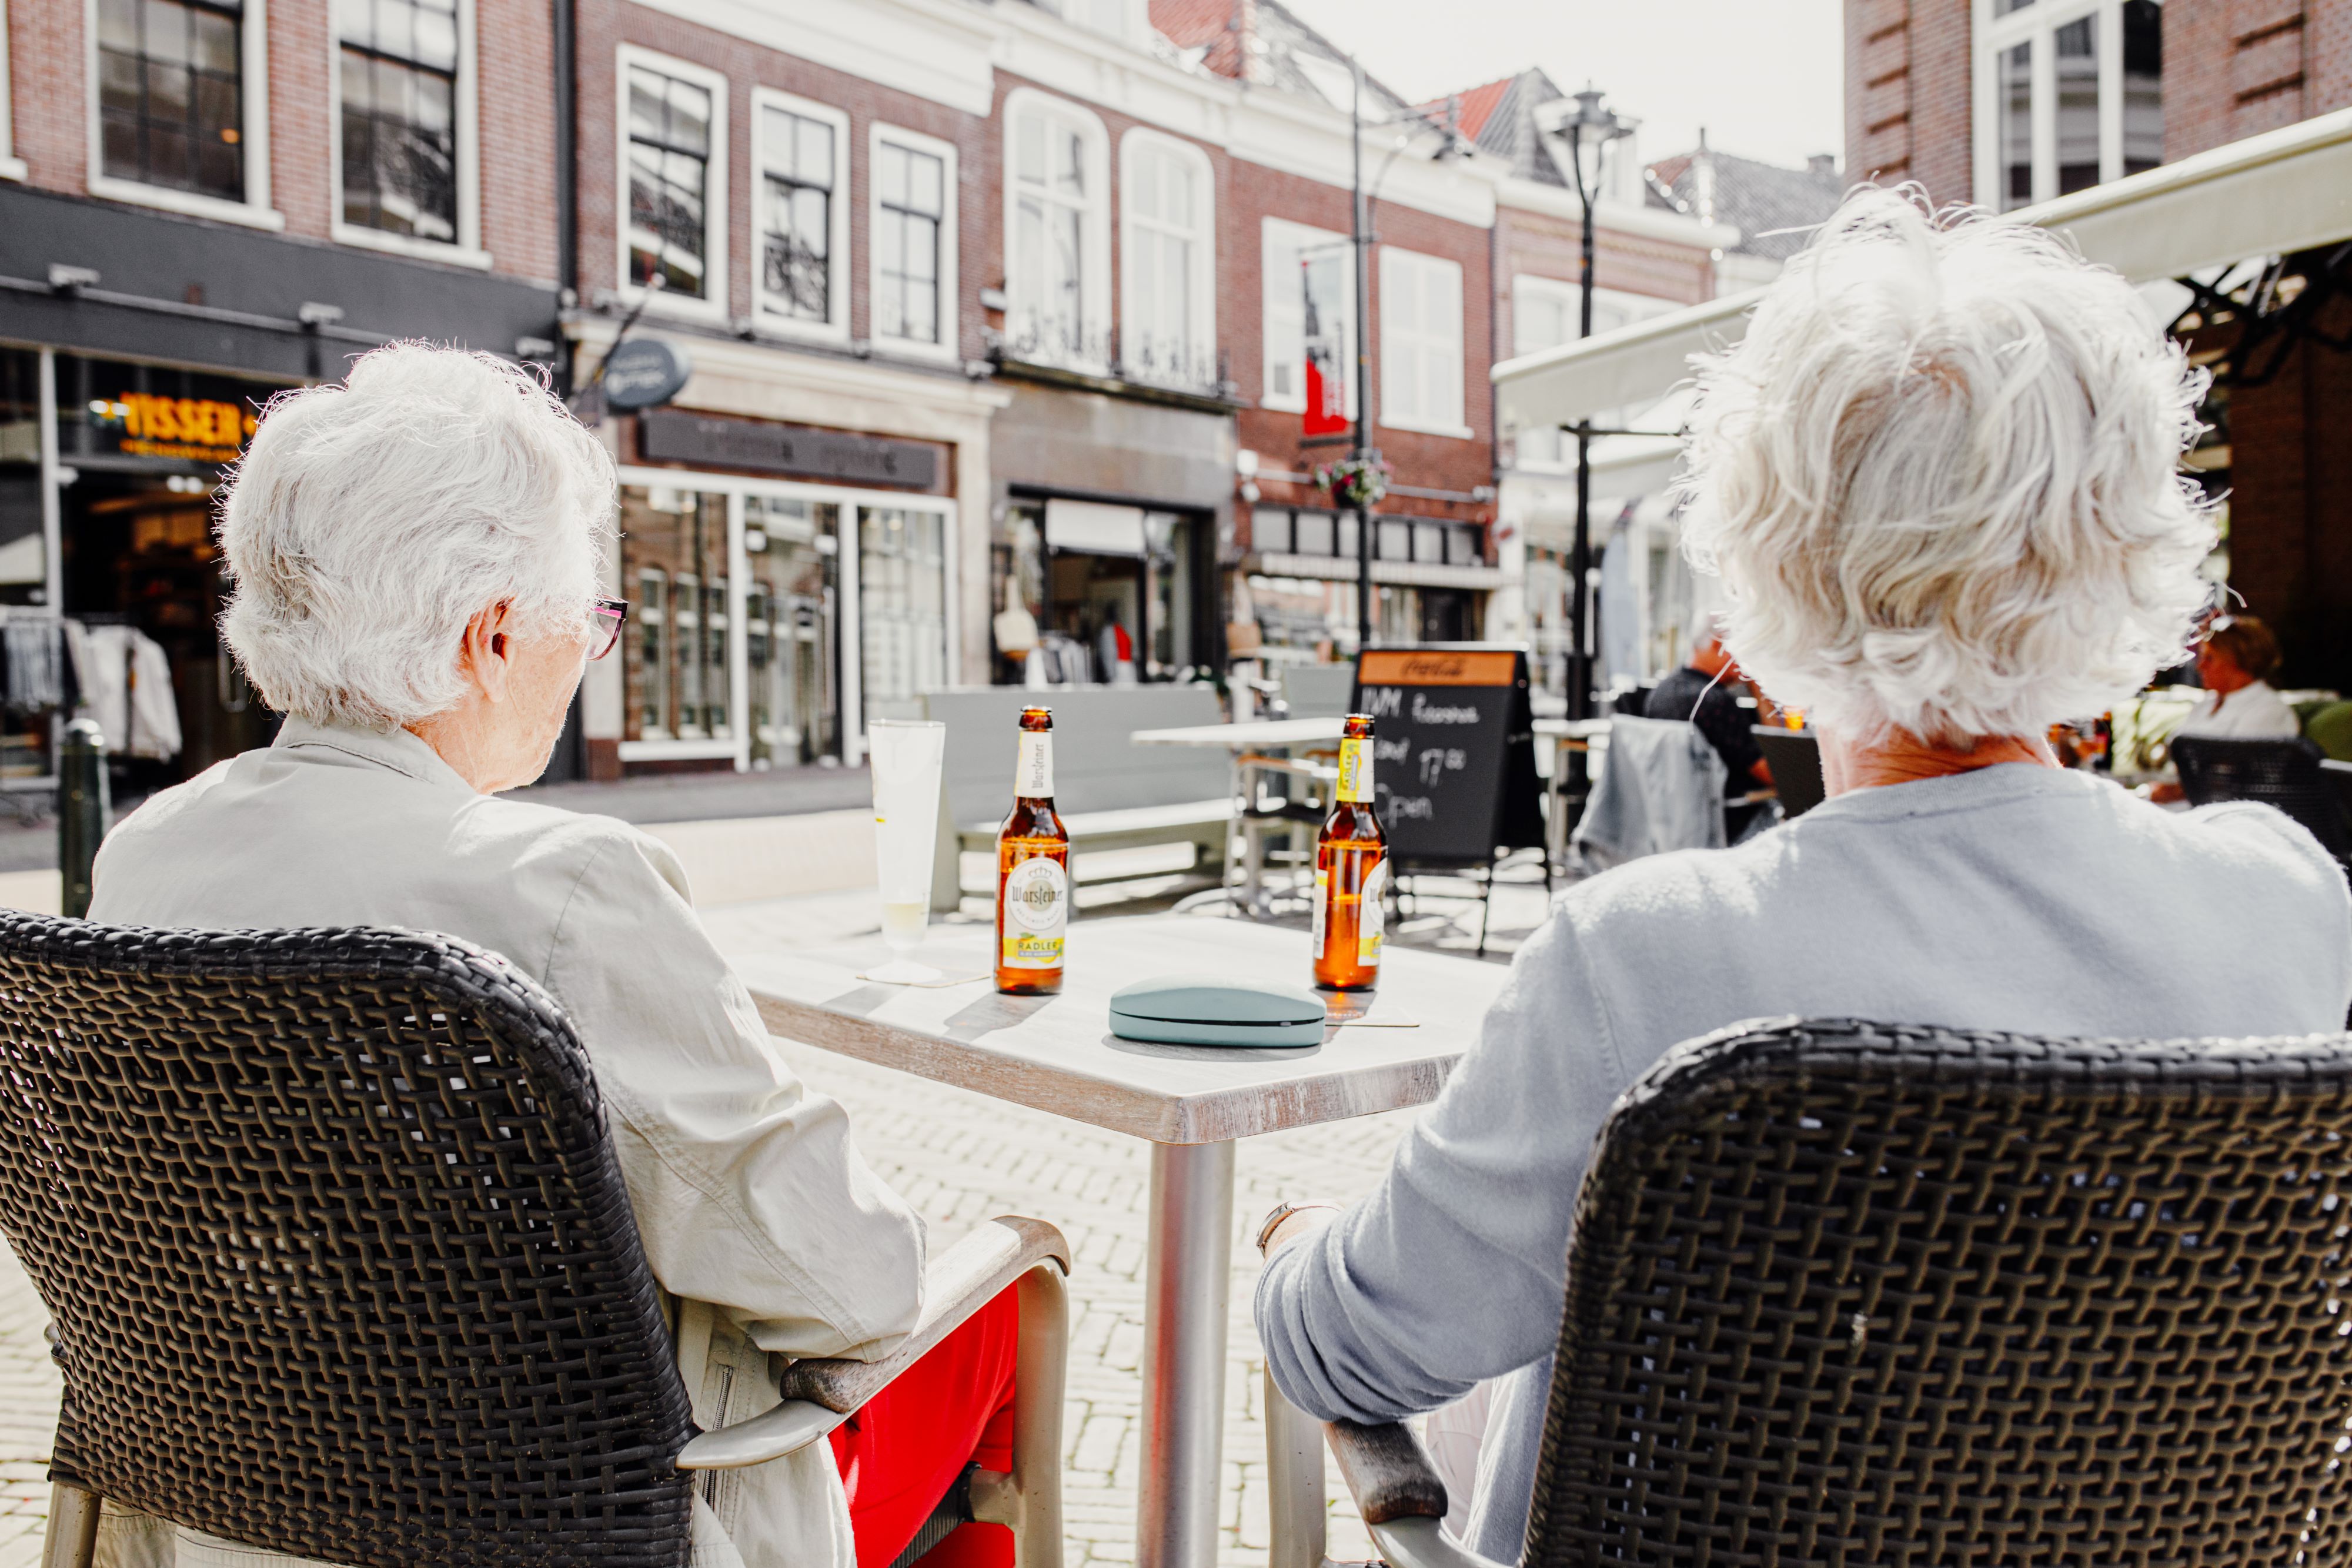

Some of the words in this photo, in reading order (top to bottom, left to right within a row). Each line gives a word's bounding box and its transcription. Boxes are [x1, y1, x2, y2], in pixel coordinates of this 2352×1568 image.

[1032, 743, 1044, 788] Warsteiner
[1012, 885, 1063, 905] Warsteiner
[1018, 942, 1058, 950] RADLER
